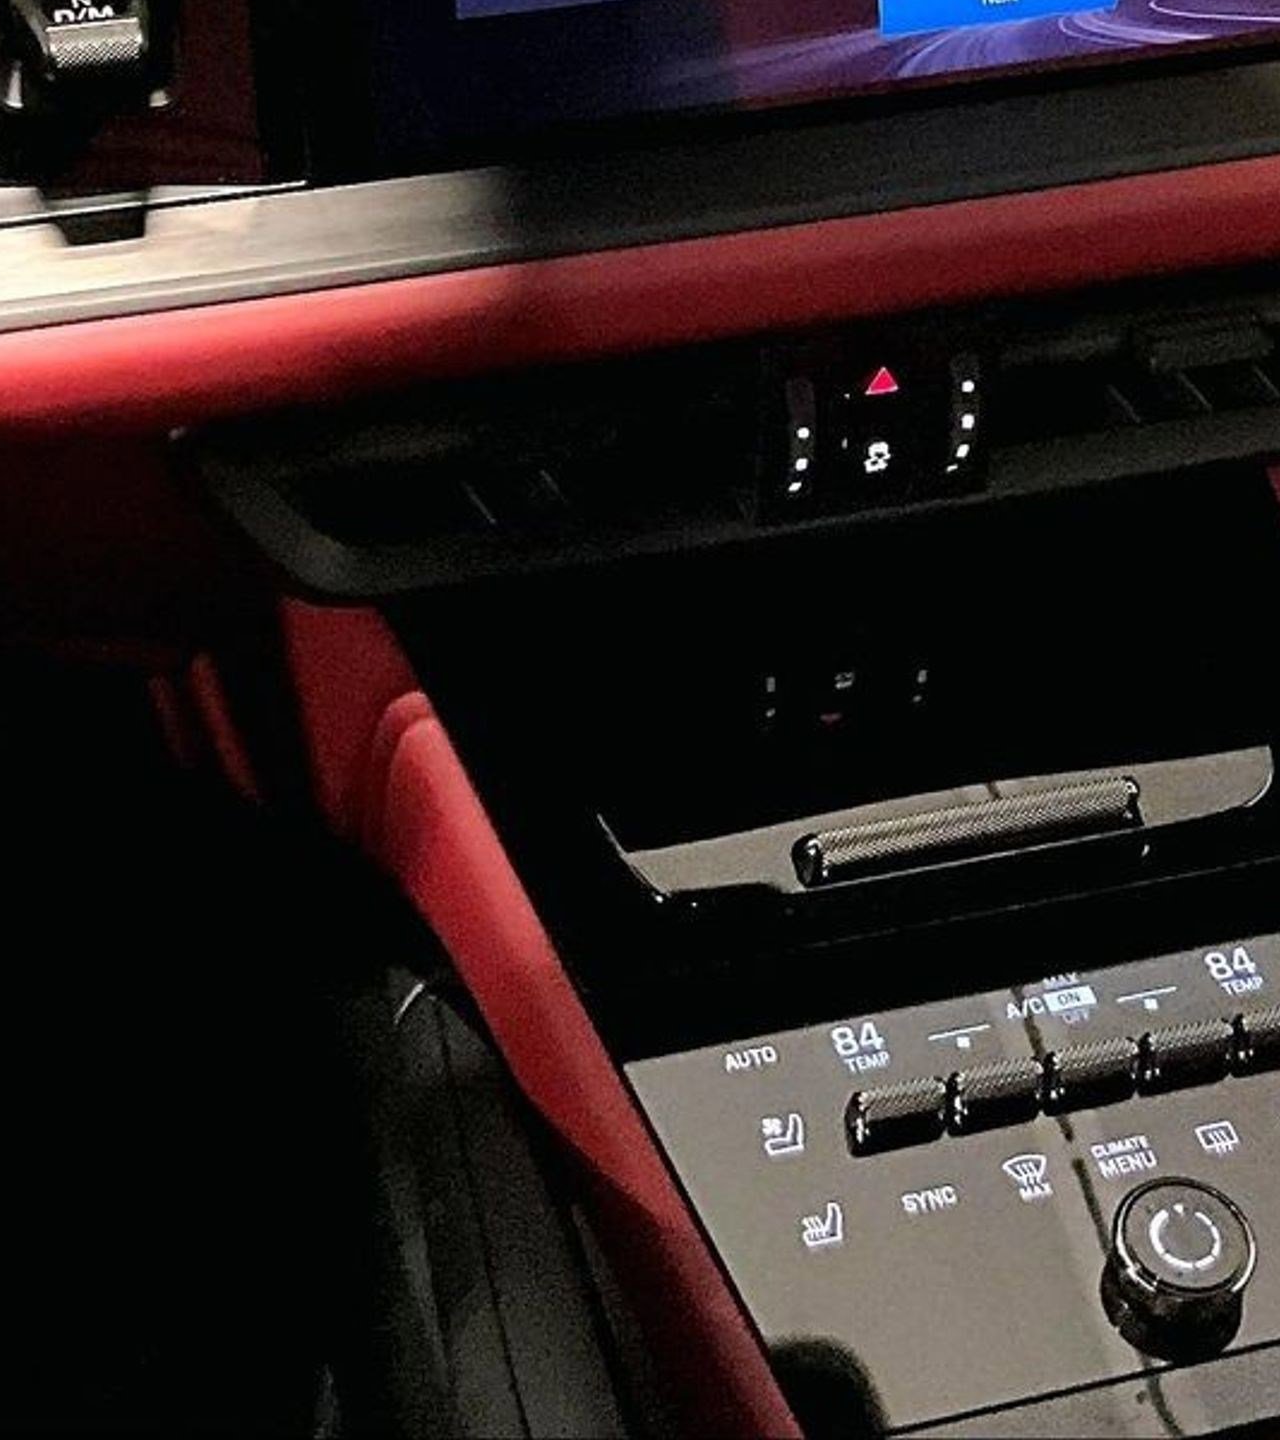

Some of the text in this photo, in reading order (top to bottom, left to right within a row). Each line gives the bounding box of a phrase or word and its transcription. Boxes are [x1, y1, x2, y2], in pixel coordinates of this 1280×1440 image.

[1204, 946, 1256, 981] 84
[1043, 972, 1079, 989] MAX
[1221, 976, 1264, 997] TEMP
[1006, 992, 1081, 1020] A/C ON
[831, 1021, 885, 1057] 84
[725, 1046, 778, 1073] AUTO
[846, 1051, 890, 1074] TEMP
[1090, 1135, 1151, 1159] CLIMATE
[1096, 1151, 1158, 1179] MENU
[901, 1185, 958, 1214] SYNC
[1019, 1183, 1054, 1201] MAX
